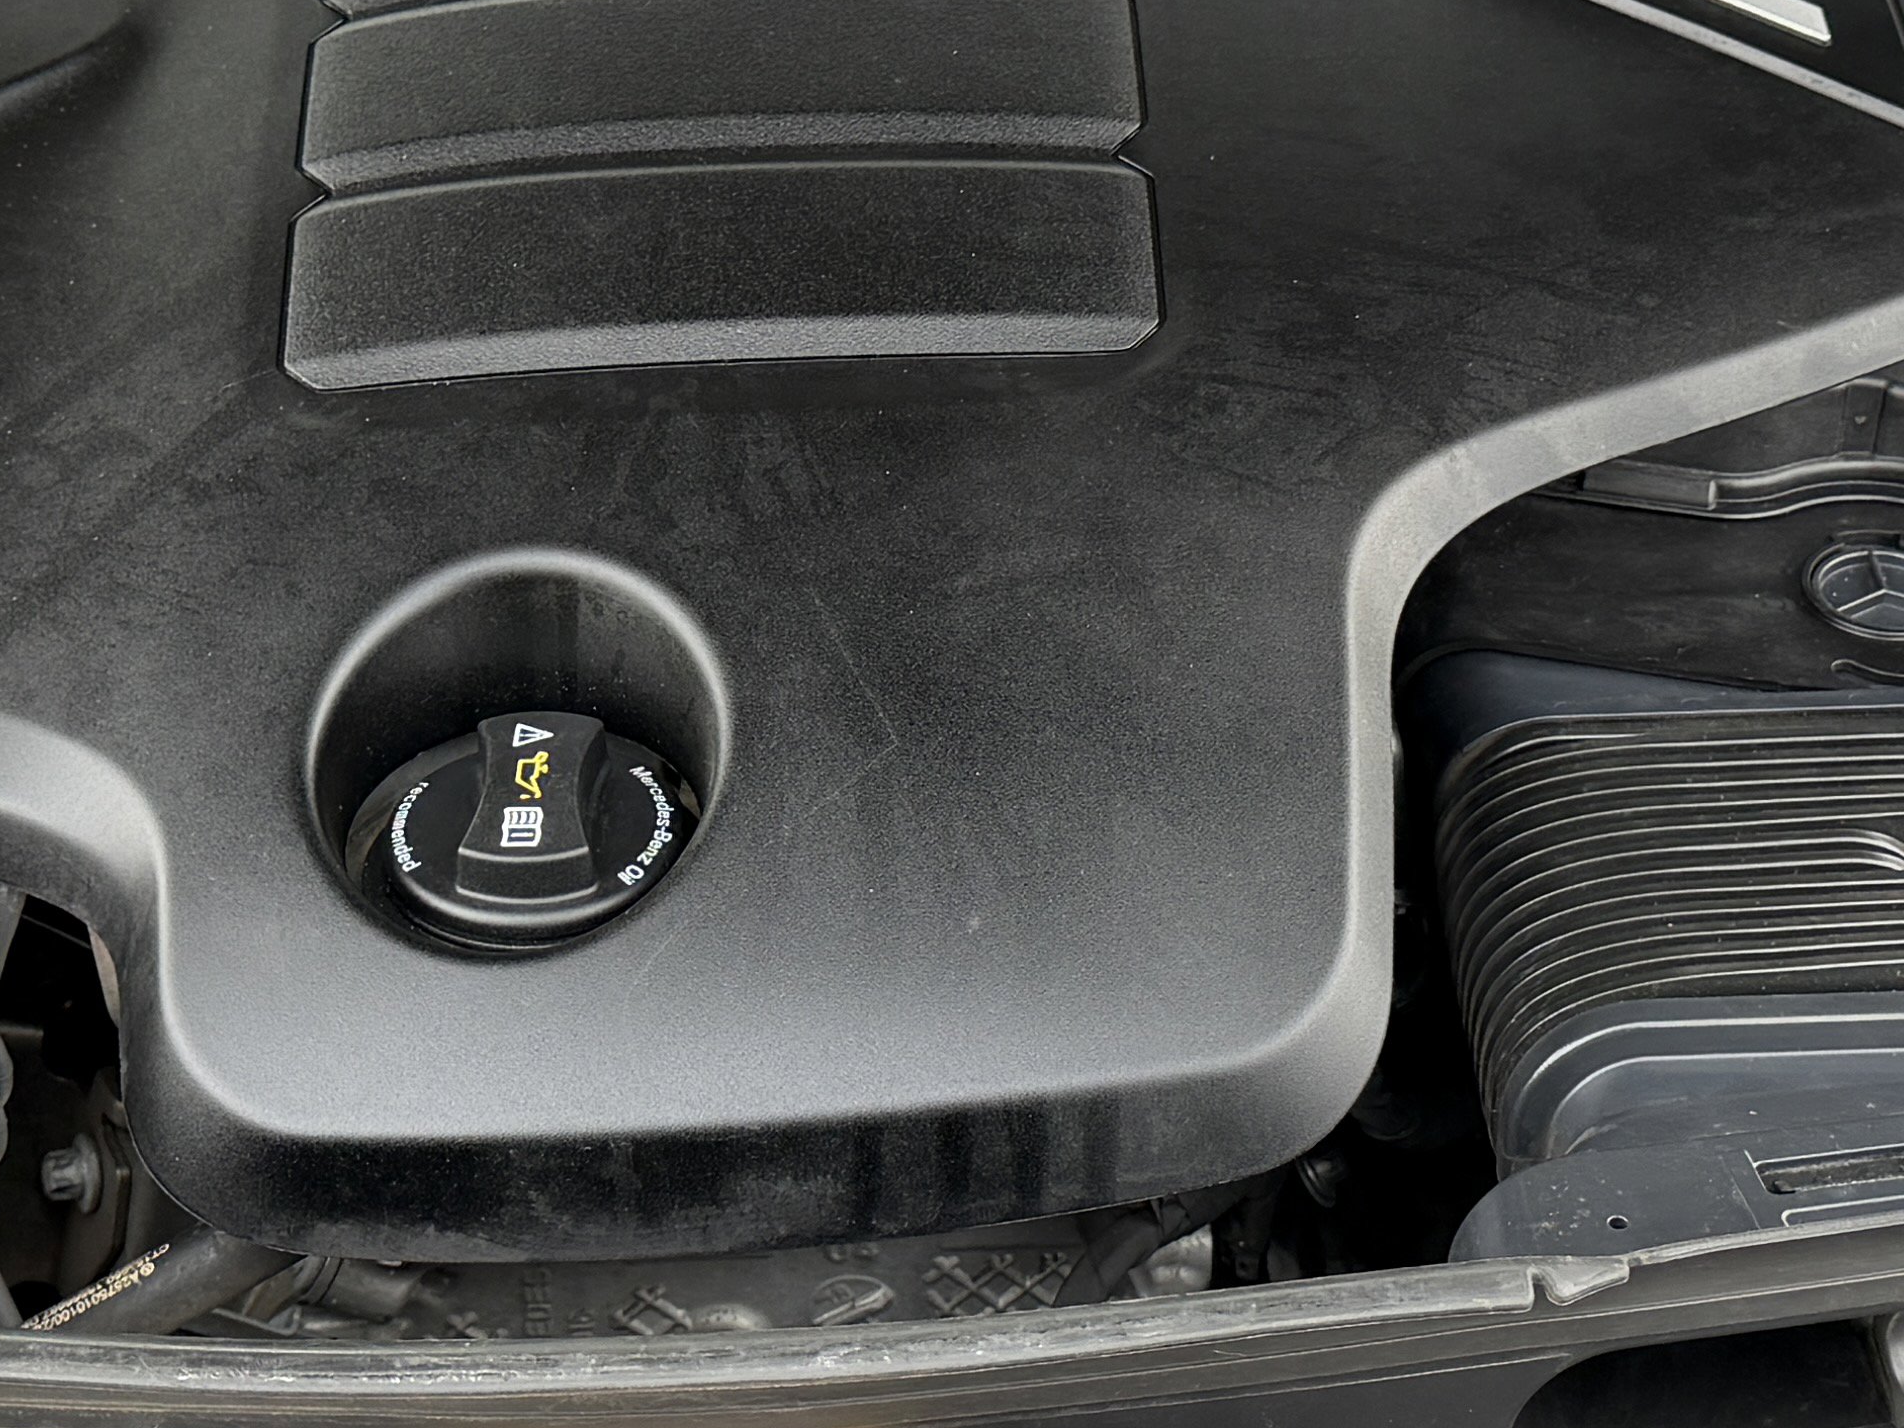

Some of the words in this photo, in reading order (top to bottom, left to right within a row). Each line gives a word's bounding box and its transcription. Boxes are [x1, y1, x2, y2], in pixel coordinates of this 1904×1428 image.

[390, 781, 430, 873] recommended
[628, 764, 675, 867] Mercedes-Benz
[616, 863, 646, 887] Oil
